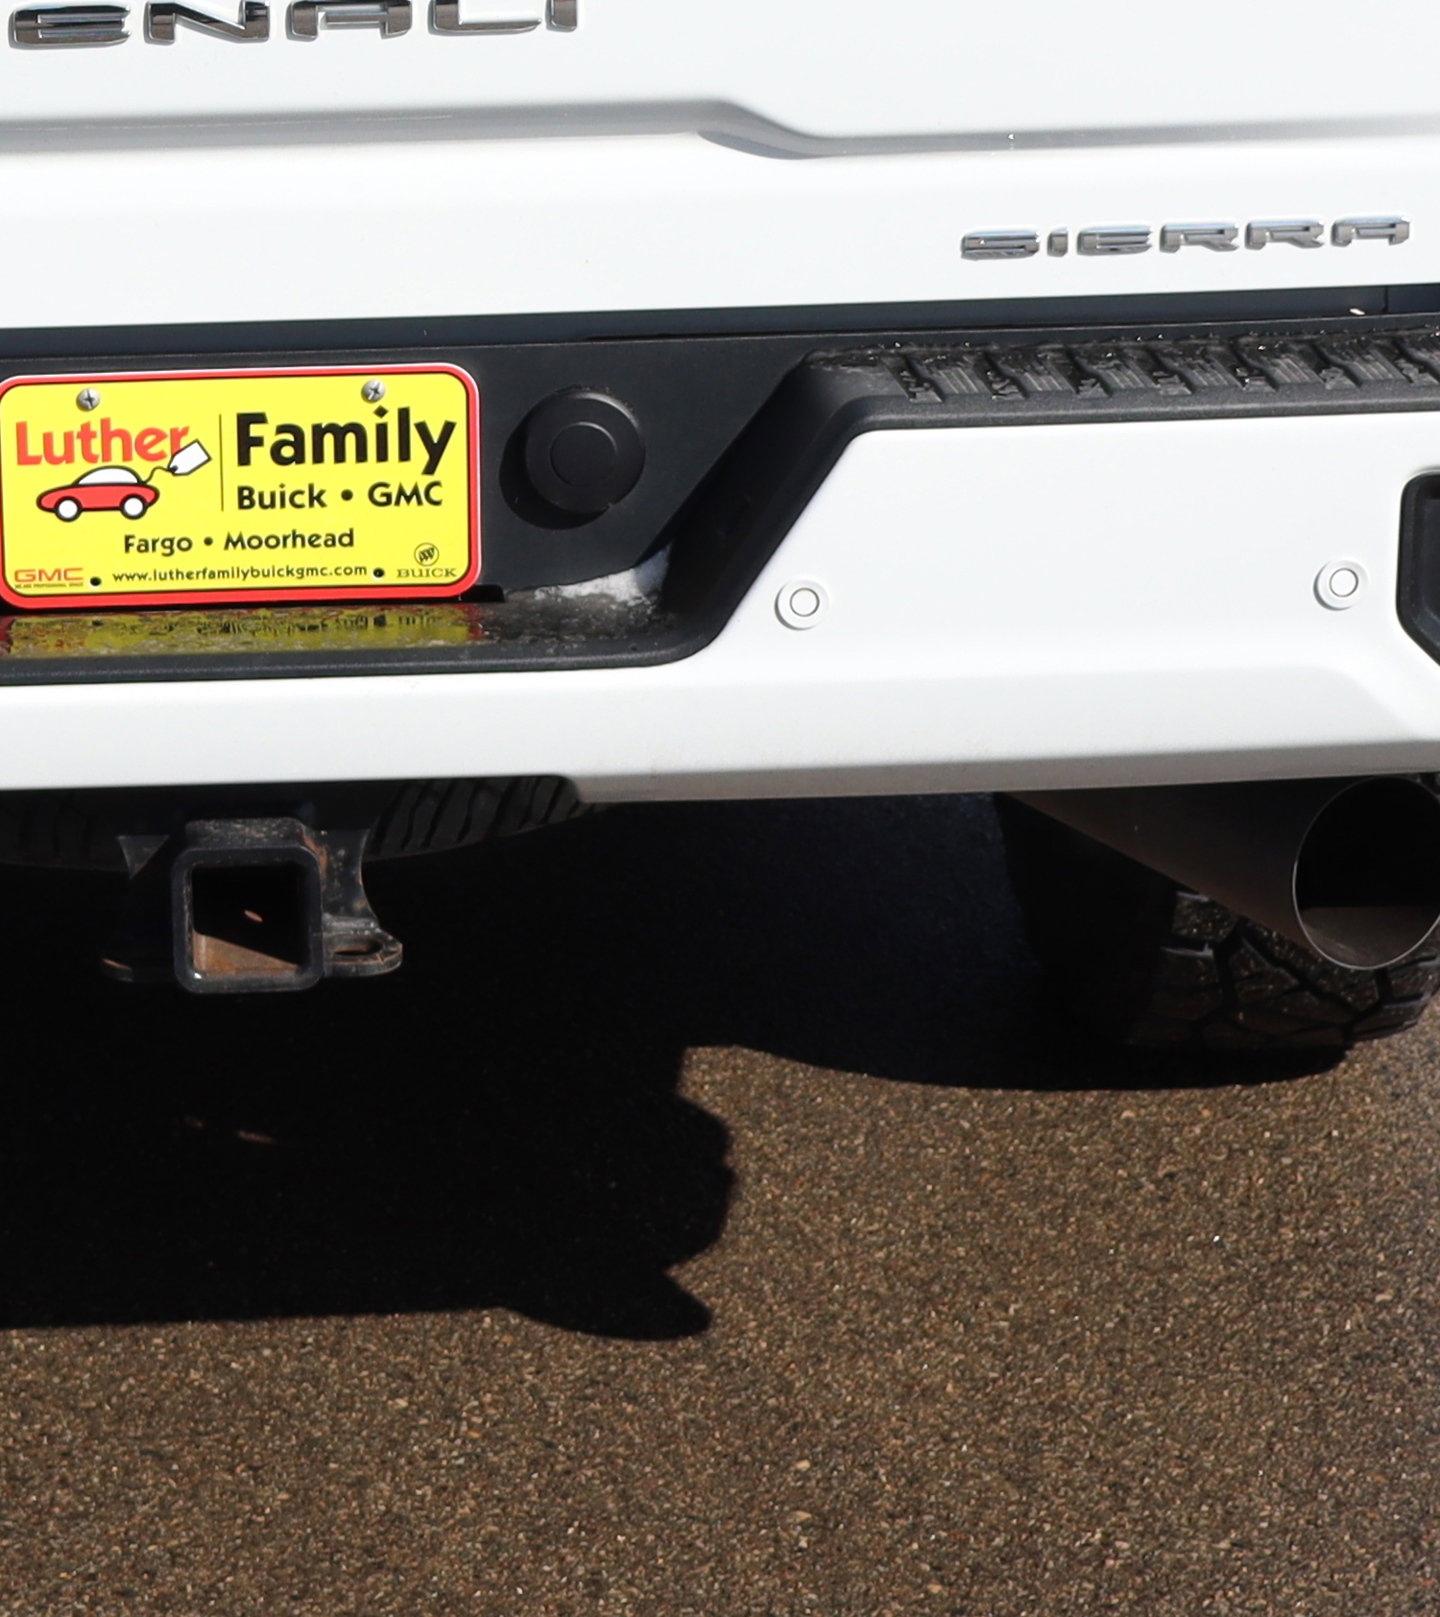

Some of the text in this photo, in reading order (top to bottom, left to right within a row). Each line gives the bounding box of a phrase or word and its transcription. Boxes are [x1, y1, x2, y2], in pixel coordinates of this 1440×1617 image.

[961, 215, 1410, 260] SIERRA
[15, 406, 457, 476] Luther Family
[237, 481, 443, 511] Buick GMC
[124, 528, 355, 557] Fargo Moorhead
[14, 567, 84, 582] GMC
[113, 565, 368, 583] www.lutherfamilybuickgmc.com
[396, 568, 457, 579] BUICK
